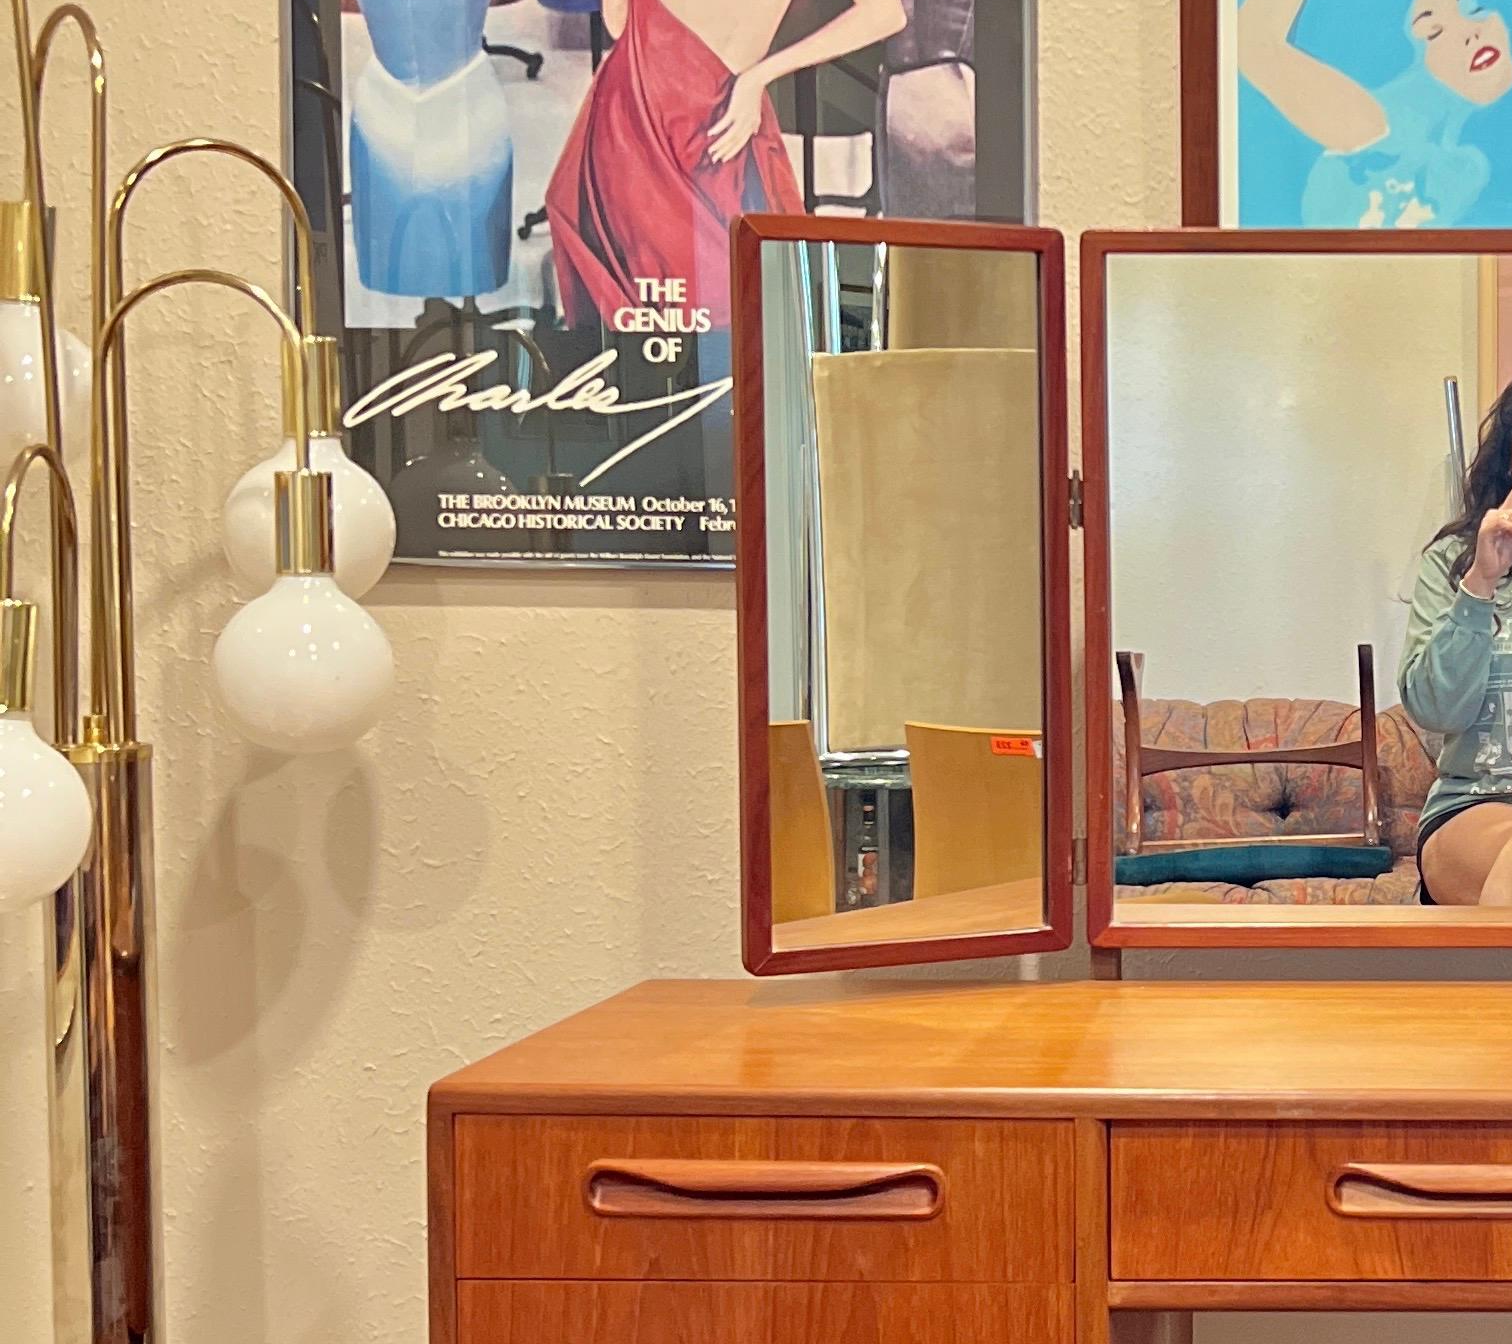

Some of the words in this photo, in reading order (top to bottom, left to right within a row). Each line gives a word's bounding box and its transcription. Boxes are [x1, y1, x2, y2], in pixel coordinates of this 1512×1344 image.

[634, 277, 687, 303] THE
[613, 306, 712, 333] GENIUS
[642, 336, 683, 363] OF
[437, 494, 471, 510] THE
[472, 494, 562, 511] BROOKLYN
[564, 495, 636, 512] MUSEUM
[642, 496, 706, 513] October
[437, 513, 517, 529] CHICAGO
[518, 514, 614, 531] HISTORICAL
[616, 515, 685, 531] SOCIETY
